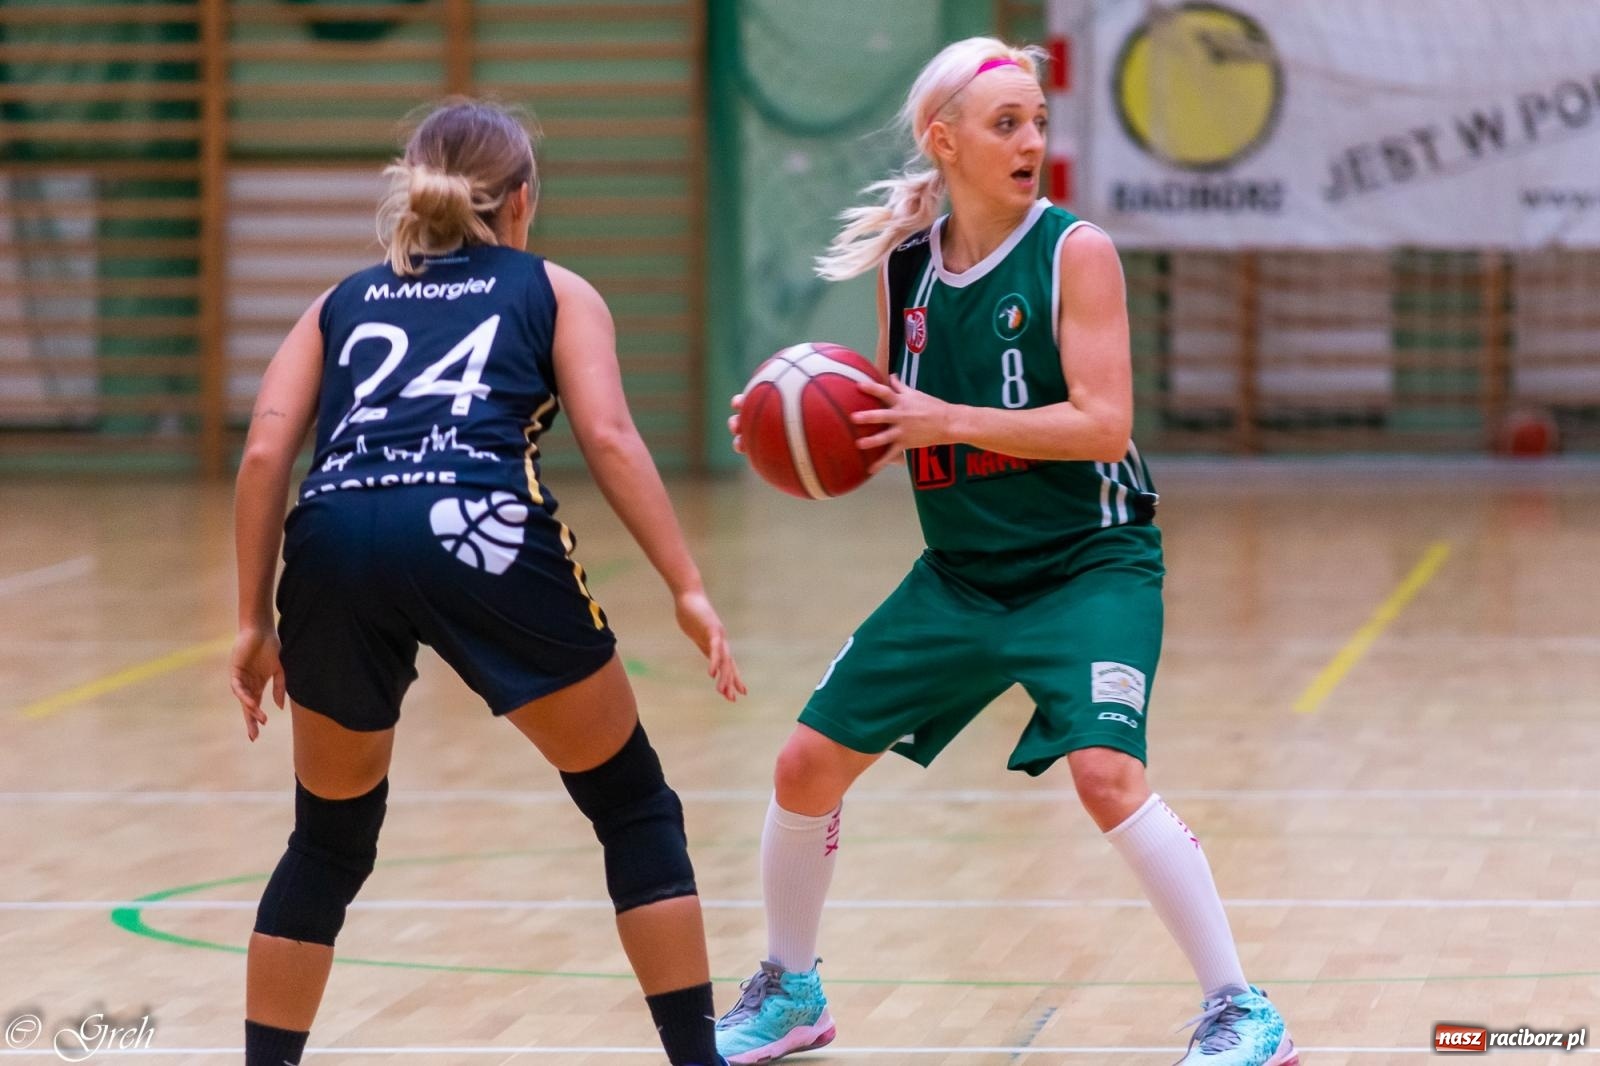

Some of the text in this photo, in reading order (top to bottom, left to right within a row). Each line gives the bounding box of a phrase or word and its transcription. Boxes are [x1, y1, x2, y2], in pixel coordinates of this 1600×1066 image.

[1455, 107, 1506, 157] W
[330, 314, 500, 441] 24
[1001, 348, 1029, 409] 8
